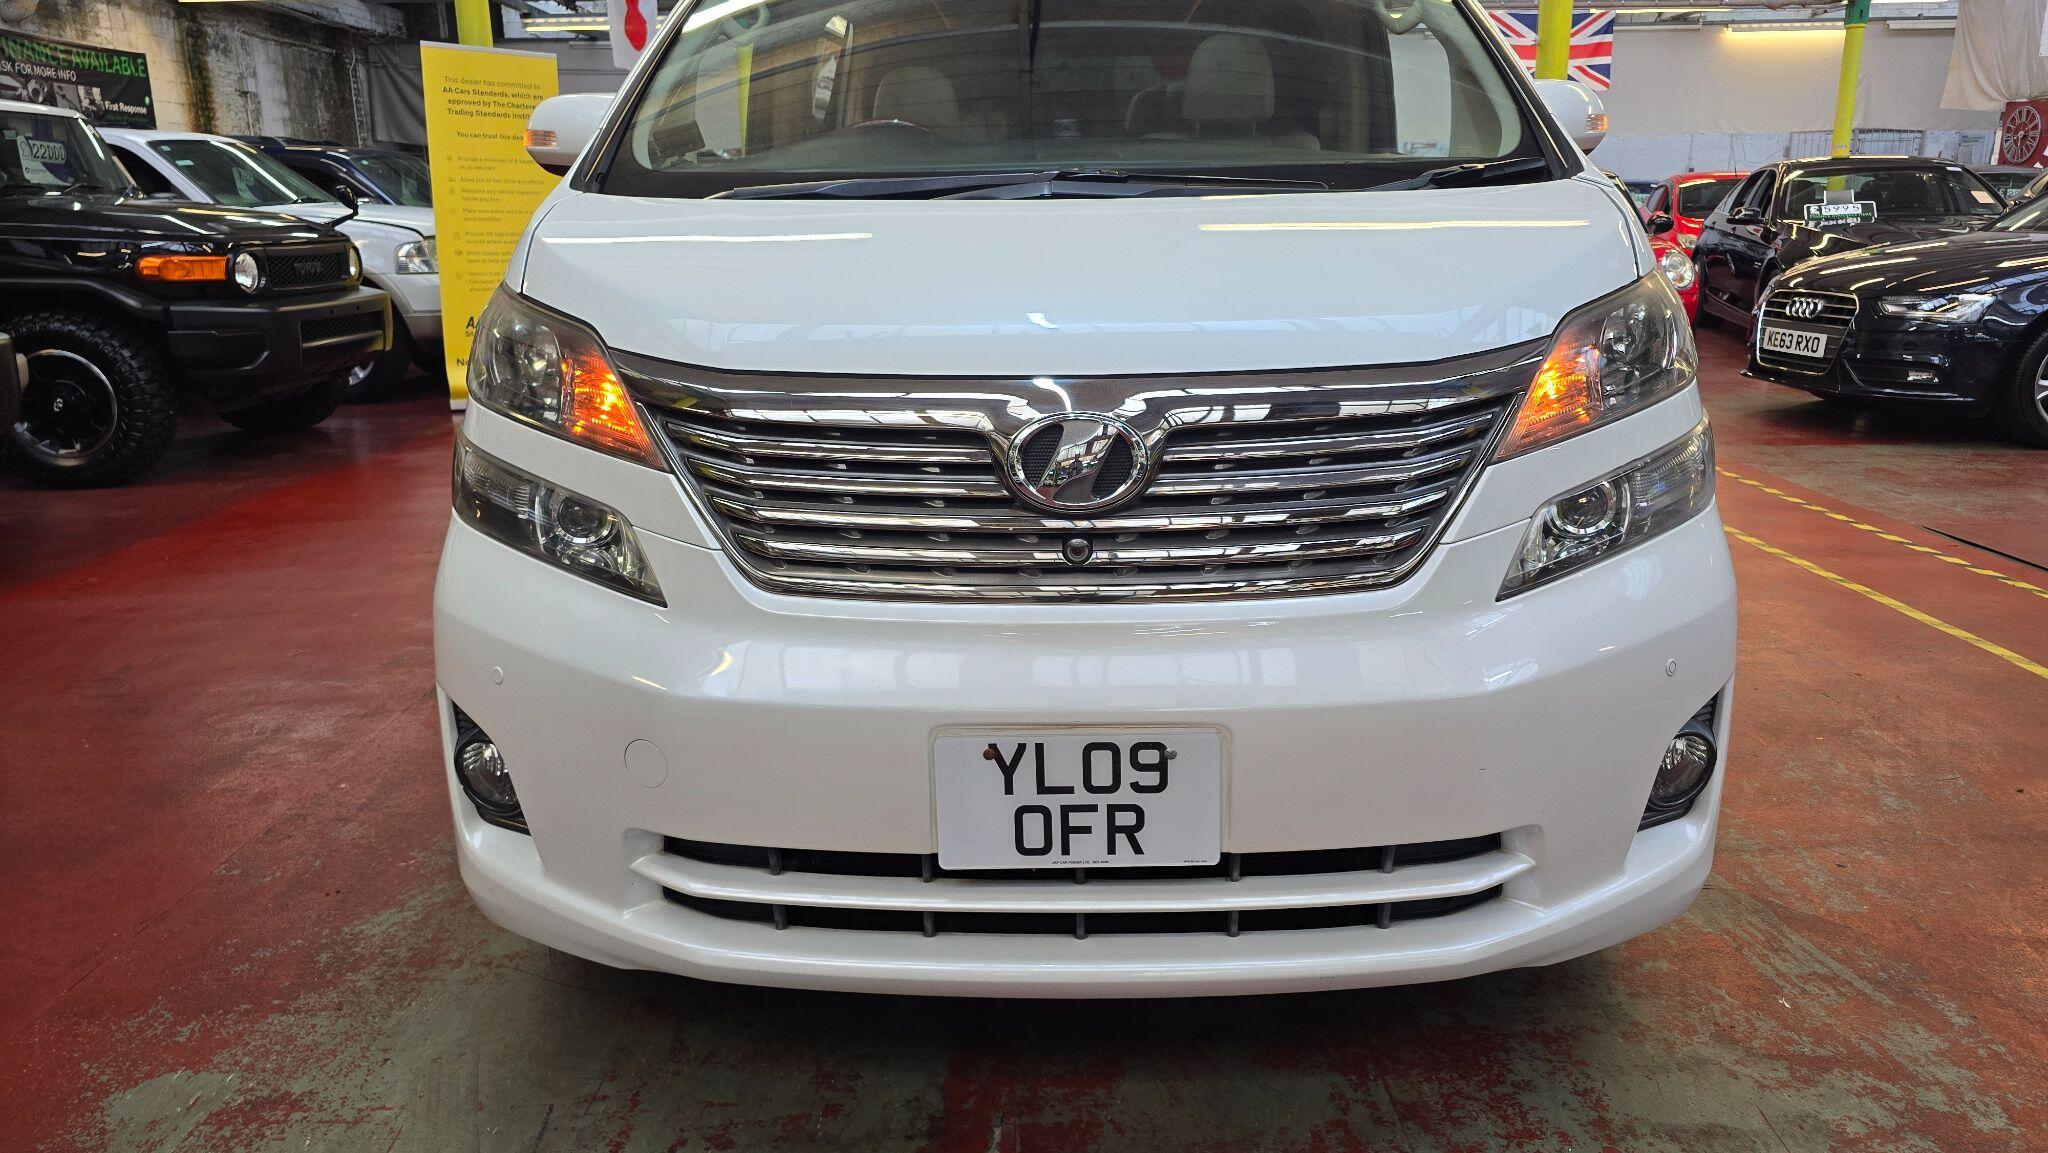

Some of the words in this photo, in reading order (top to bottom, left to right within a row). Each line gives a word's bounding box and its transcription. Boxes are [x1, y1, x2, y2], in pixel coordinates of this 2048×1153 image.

[0, 36, 69, 67] INANCE
[72, 48, 147, 77] AVAILABLE
[0, 60, 13, 72] SK
[15, 62, 33, 75] FOR
[33, 64, 57, 78] MORE
[58, 68, 77, 82] INFO
[444, 75, 459, 84] This
[460, 76, 482, 86] dealer
[483, 78, 495, 87] has
[496, 81, 532, 90] committed
[442, 86, 453, 94] AA
[454, 87, 471, 96] Cars
[511, 91, 532, 100] which
[104, 100, 119, 112] First
[119, 102, 148, 115] Response
[447, 98, 482, 108] approved
[482, 99, 491, 109] by
[492, 100, 505, 108] The
[506, 101, 536, 110] Chartere
[446, 107, 474, 118] Trading
[475, 109, 511, 119] Standards
[456, 130, 469, 138] You
[482, 132, 499, 140] trust
[1766, 330, 1793, 350] KE63
[1795, 332, 1821, 353] RXO
[987, 741, 1169, 796] YL09
[1014, 803, 1145, 857] OFR
